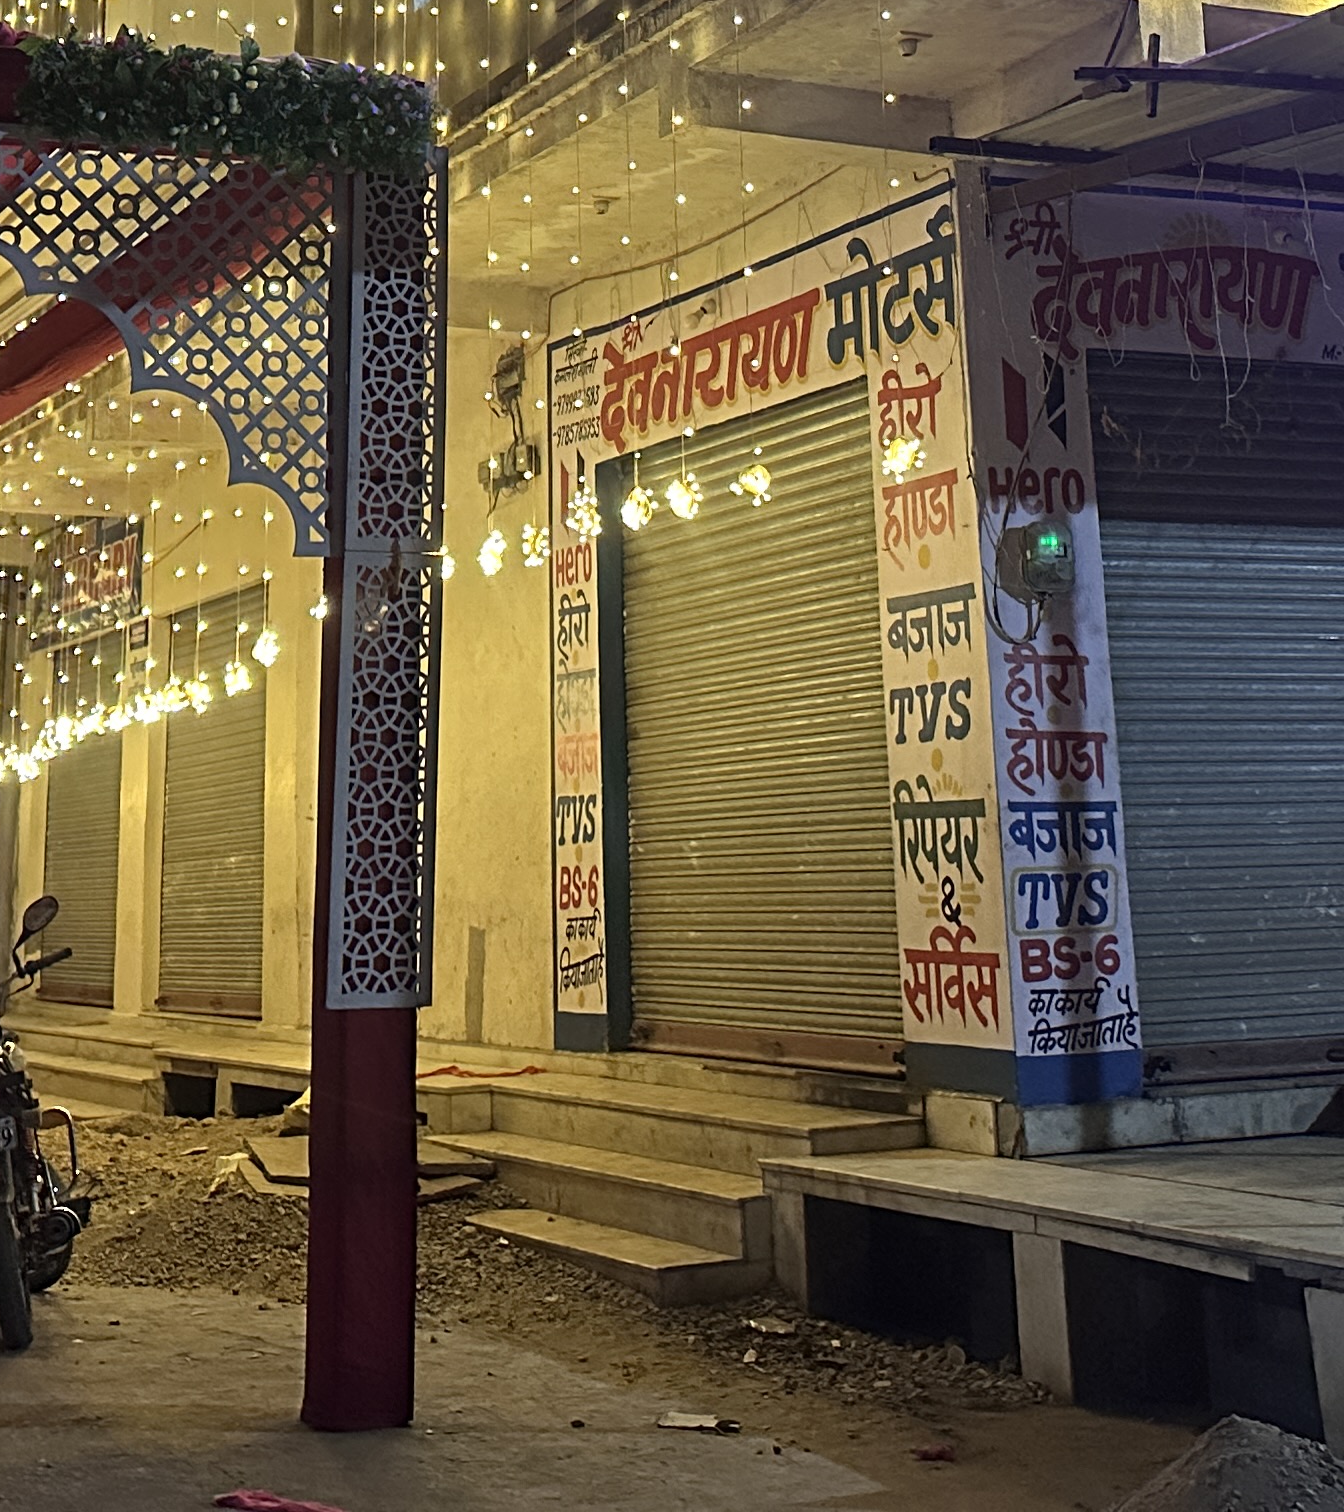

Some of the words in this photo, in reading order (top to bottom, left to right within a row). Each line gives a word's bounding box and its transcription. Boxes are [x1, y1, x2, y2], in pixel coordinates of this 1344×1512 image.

[1004, 203, 1062, 260] श्री
[601, 288, 822, 452] देवनारायण
[824, 205, 957, 364] मोटर्स
[1030, 237, 1321, 362] देवनारायण
[988, 466, 1086, 515] Hero
[556, 543, 593, 588] Hero
[557, 589, 591, 660] हीरो
[886, 583, 976, 663] बजाज
[1004, 634, 1090, 717] हीरो
[889, 677, 971, 745] TVS
[1005, 718, 1109, 796] होण्डा
[556, 794, 597, 846] TVS
[893, 774, 986, 884] रिपेयर
[1007, 800, 1119, 862] बजाज
[559, 865, 599, 910] BS-6
[941, 876, 962, 927] &
[1018, 870, 1110, 929] TVS
[903, 925, 1001, 1033] सर्विस
[1019, 934, 1121, 984] BS-6
